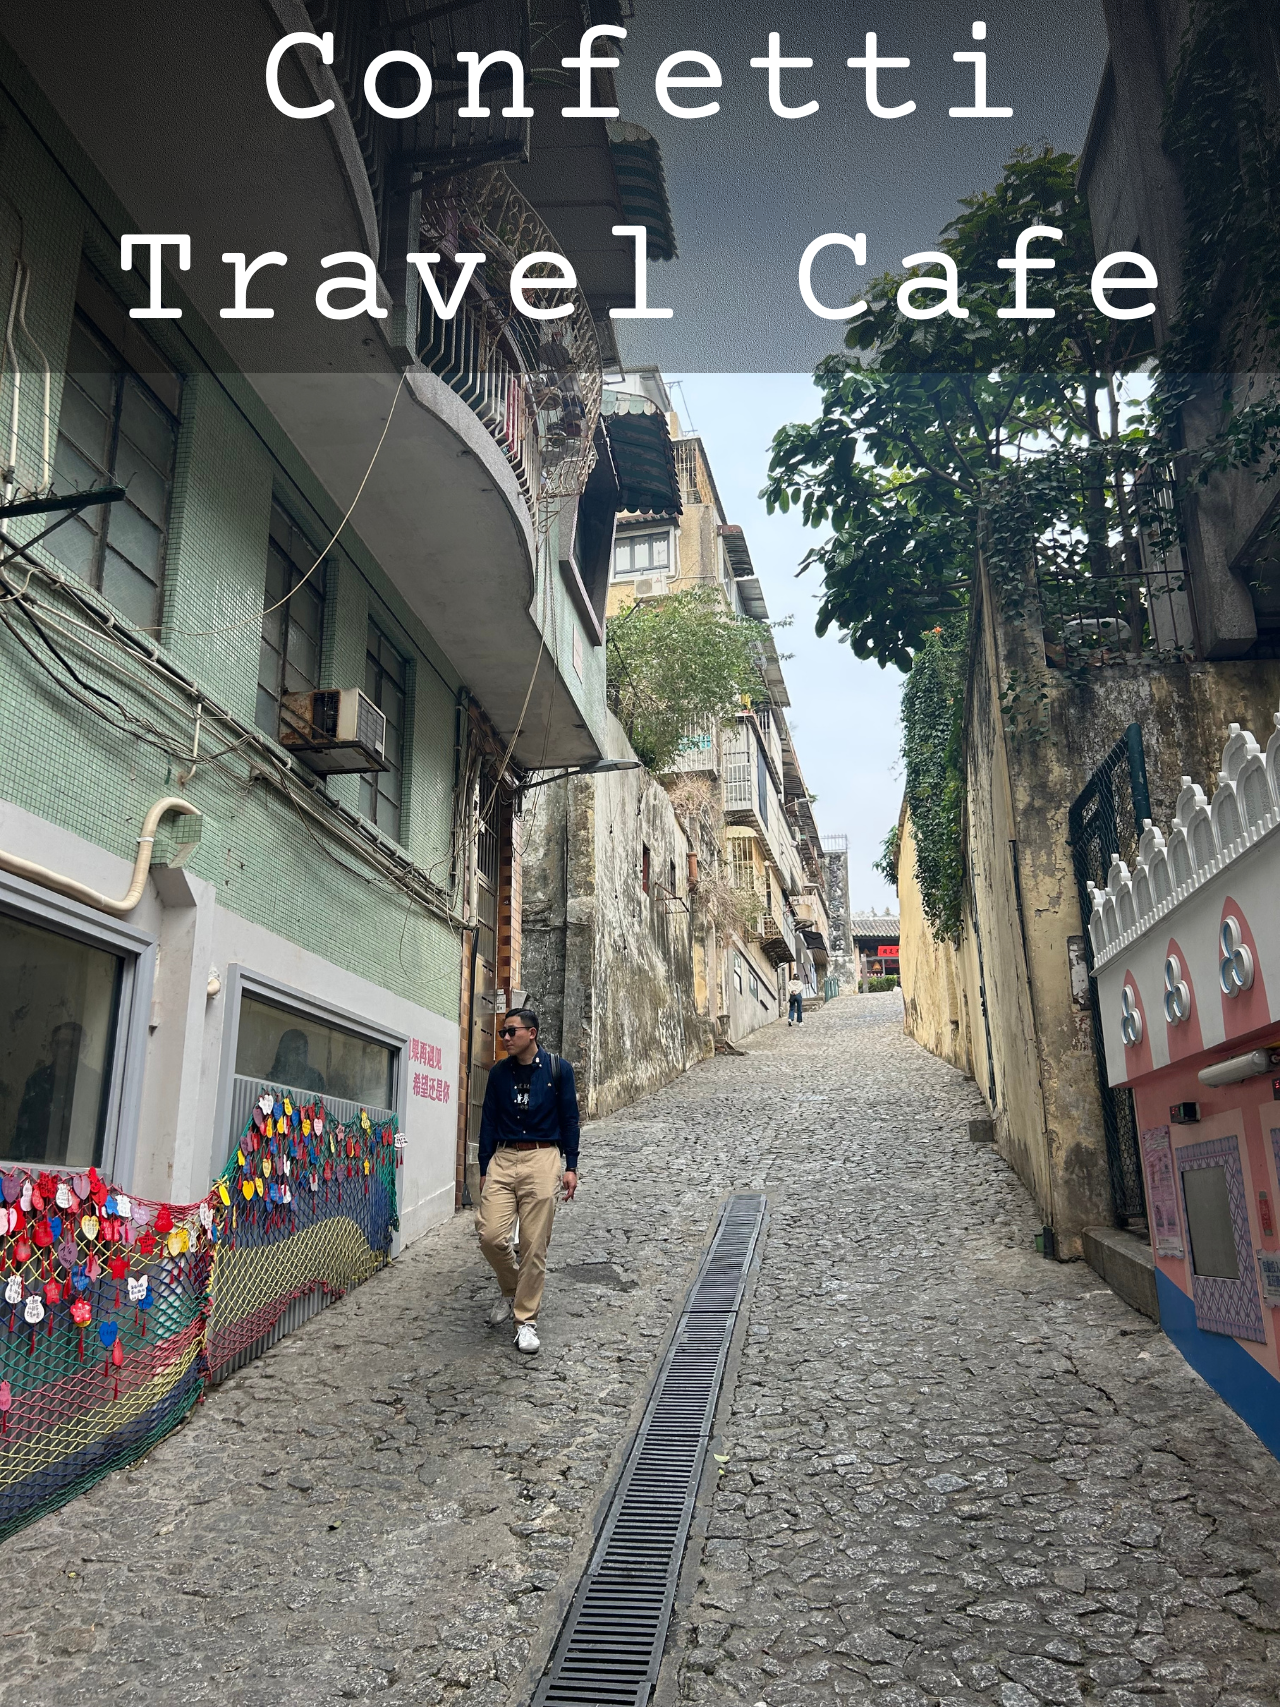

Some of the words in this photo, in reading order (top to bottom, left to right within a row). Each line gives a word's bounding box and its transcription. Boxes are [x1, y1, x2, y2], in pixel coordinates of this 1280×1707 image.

[409, 1037, 442, 1070] 果再遇见
[413, 1072, 450, 1104] 希望还是你
